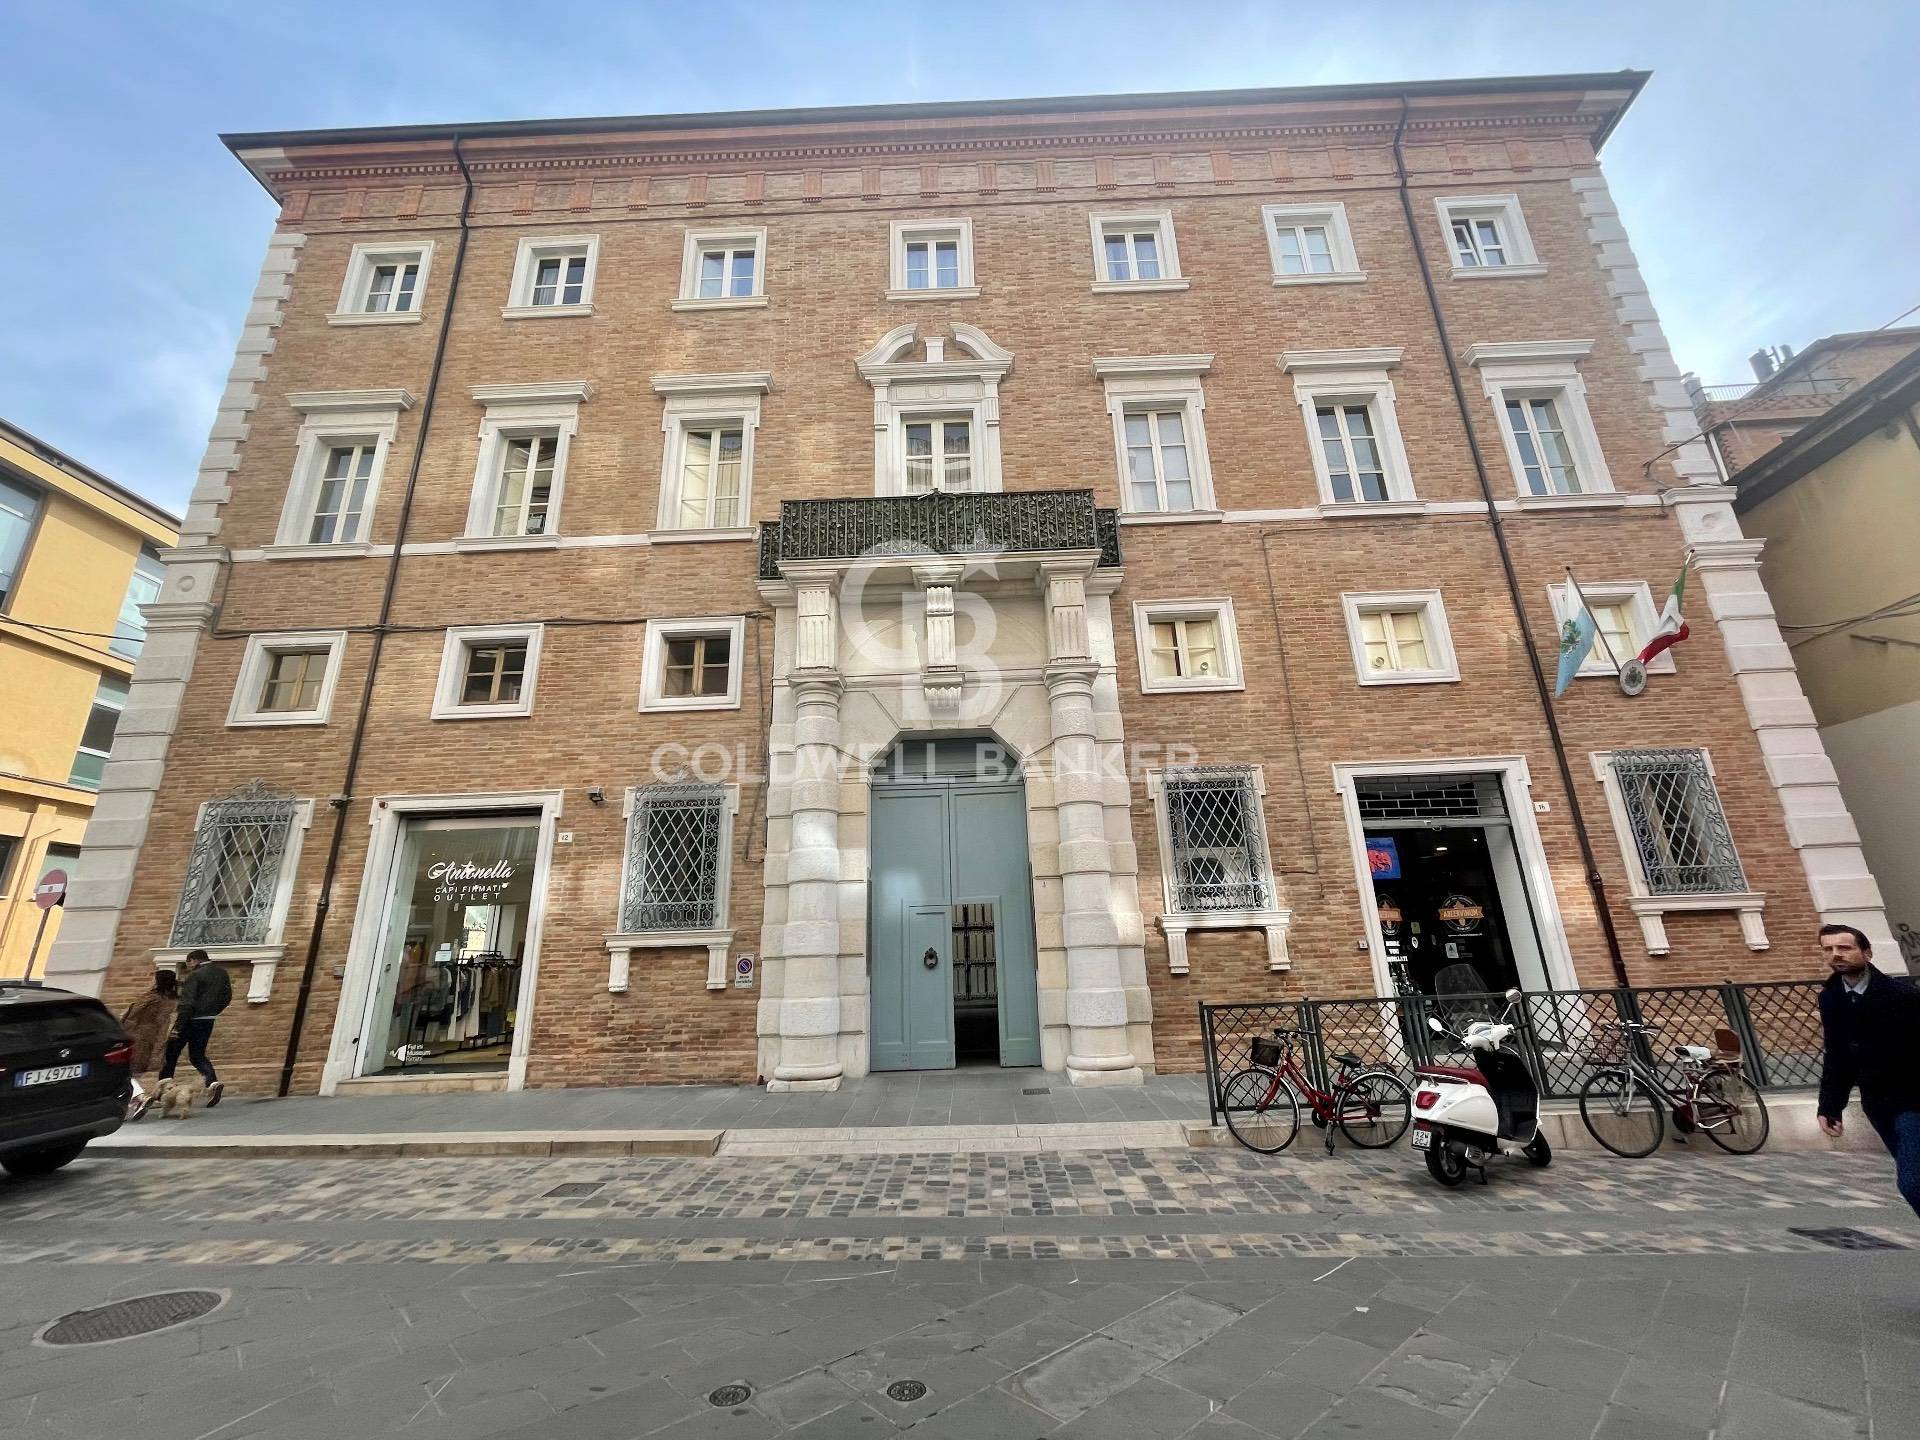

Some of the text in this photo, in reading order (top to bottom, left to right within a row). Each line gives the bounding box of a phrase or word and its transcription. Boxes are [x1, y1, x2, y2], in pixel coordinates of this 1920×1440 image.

[427, 859, 516, 886] Antonella
[435, 884, 502, 894] CAPI FIRMATI
[433, 892, 501, 902] OUTLET
